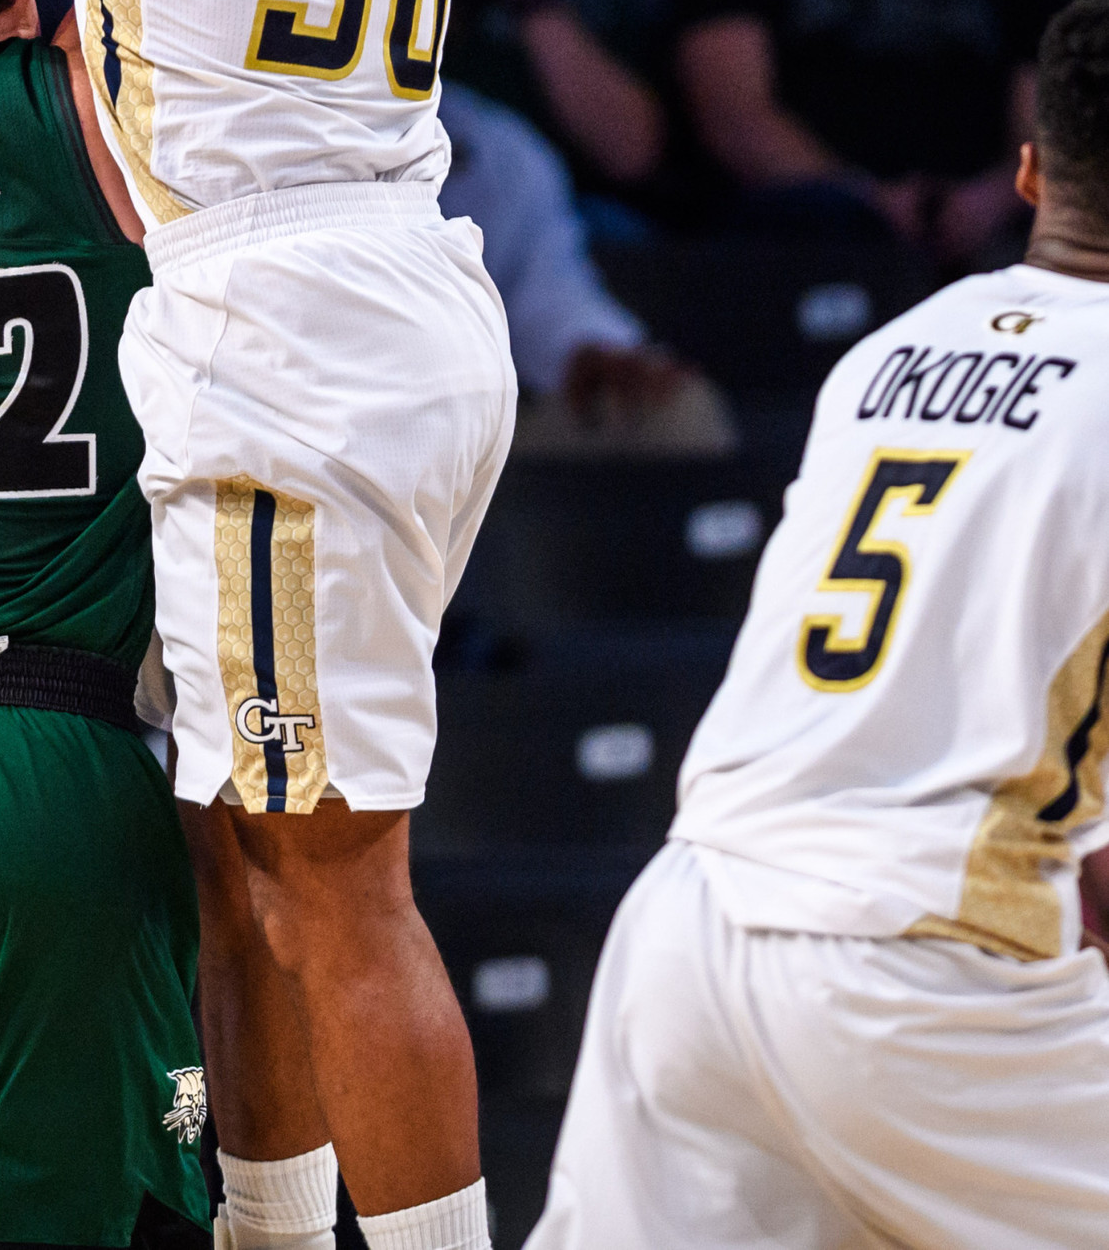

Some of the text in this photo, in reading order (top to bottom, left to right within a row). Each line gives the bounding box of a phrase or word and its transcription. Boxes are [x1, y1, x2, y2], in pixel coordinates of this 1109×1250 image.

[855, 345, 1077, 431] OKOGIE
[795, 447, 974, 694] 5
[235, 696, 315, 753] GT
